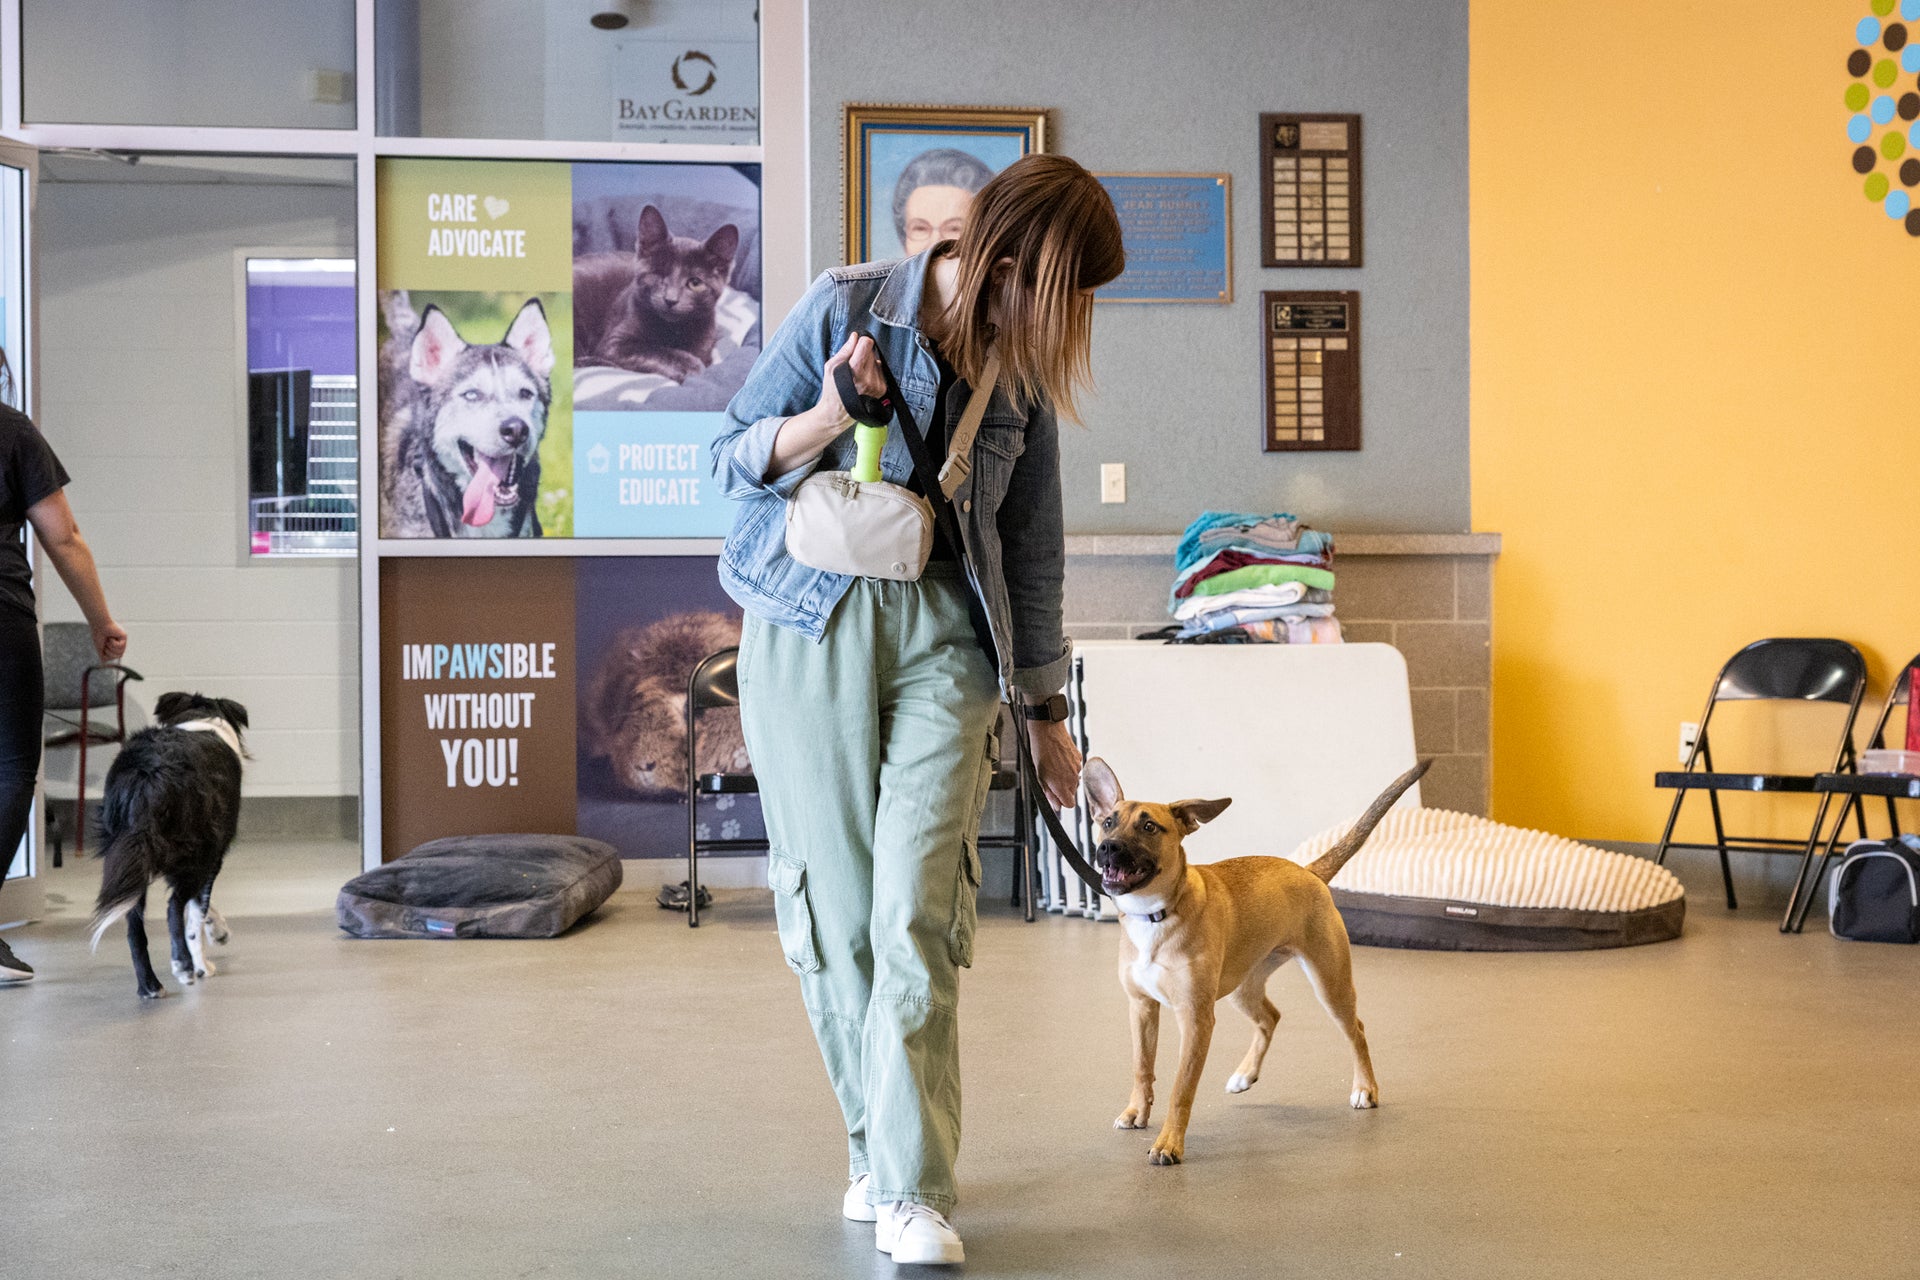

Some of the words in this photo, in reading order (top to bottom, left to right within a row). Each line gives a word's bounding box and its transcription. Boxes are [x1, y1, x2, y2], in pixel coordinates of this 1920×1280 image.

[428, 193, 477, 222] CARE
[428, 228, 526, 257] ADVOCATE
[619, 444, 699, 471] PROTECT
[619, 478, 699, 505] EDUCATE
[403, 643, 556, 680] IMPAWSIBLE
[424, 692, 536, 730] WITHOUT
[440, 737, 519, 788] YOU!
